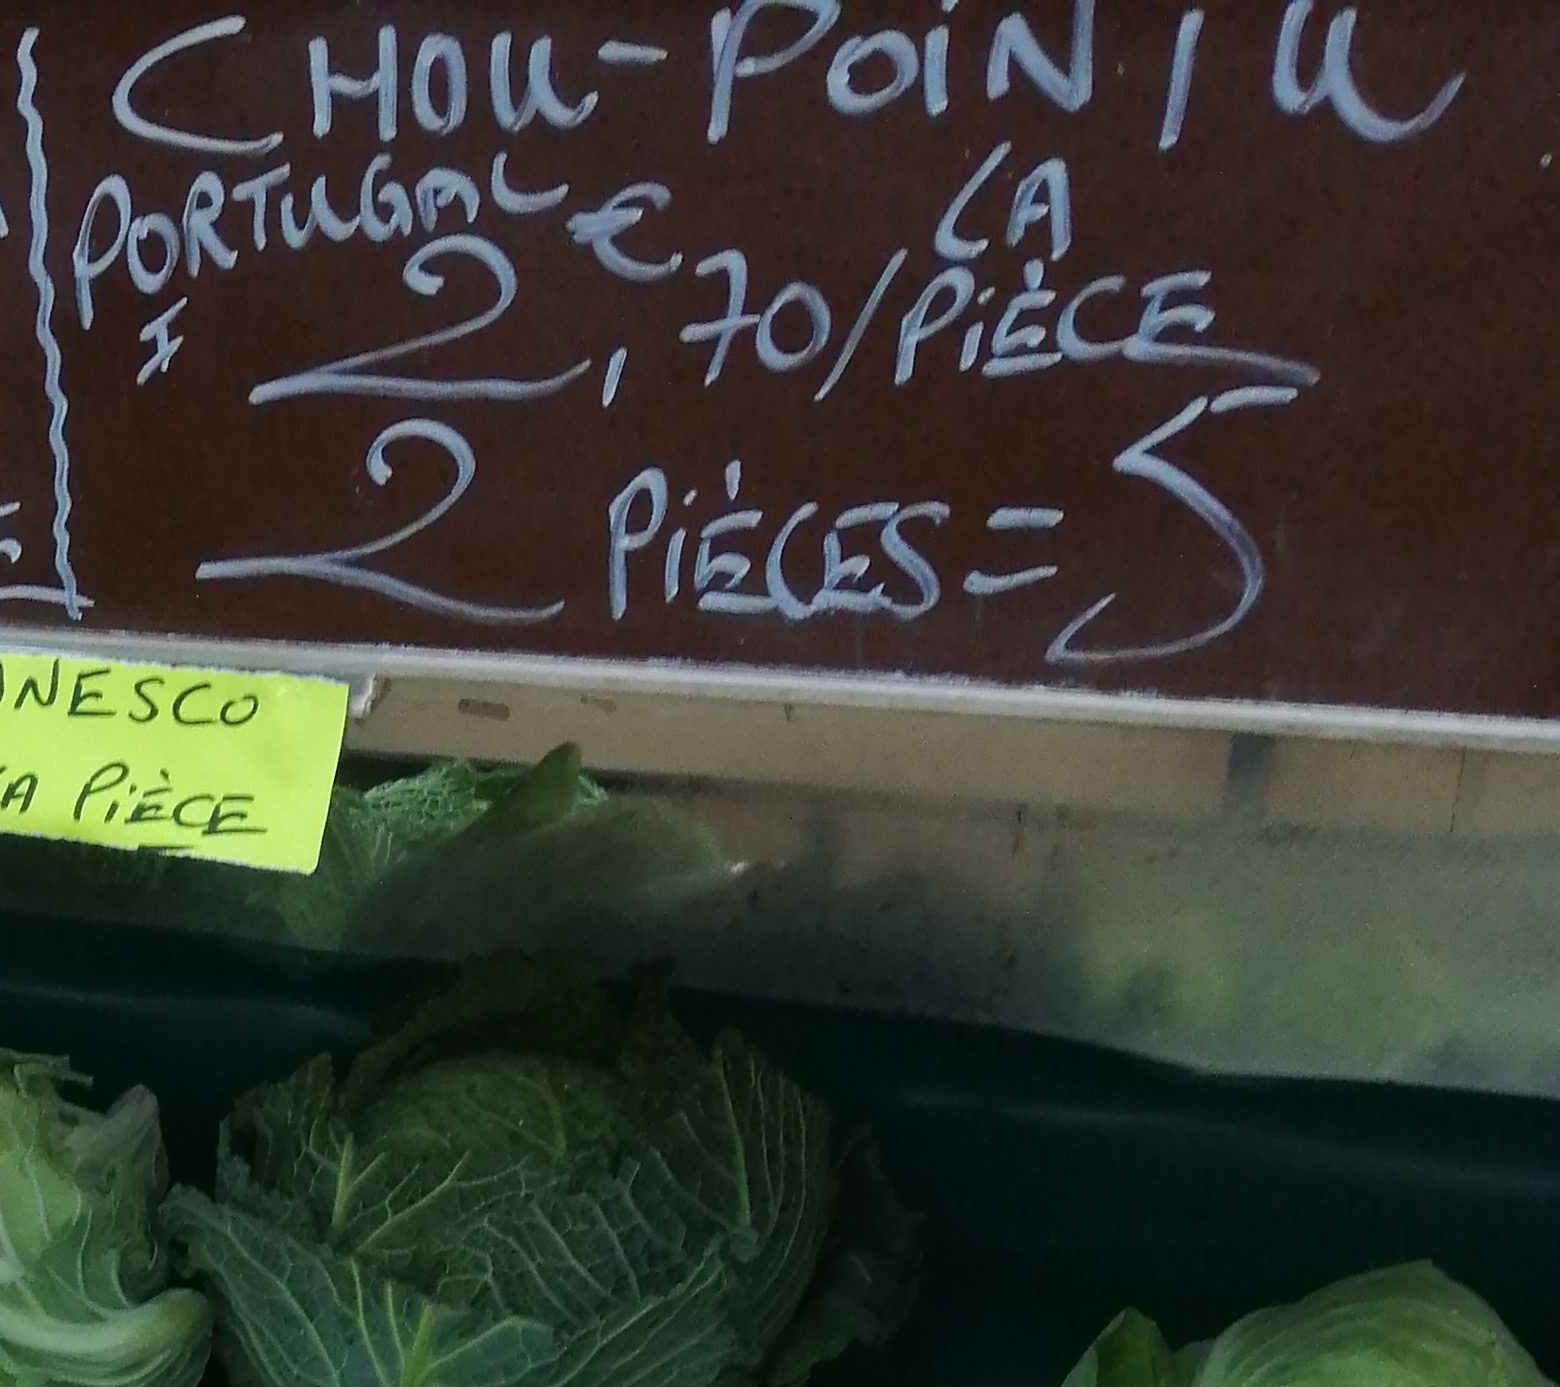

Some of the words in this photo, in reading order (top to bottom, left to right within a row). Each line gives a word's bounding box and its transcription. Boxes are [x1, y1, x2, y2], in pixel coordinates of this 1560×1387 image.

[73, 151, 570, 331] PORTUGAL
[935, 140, 1072, 262] LA
[196, 417, 565, 626] 2
